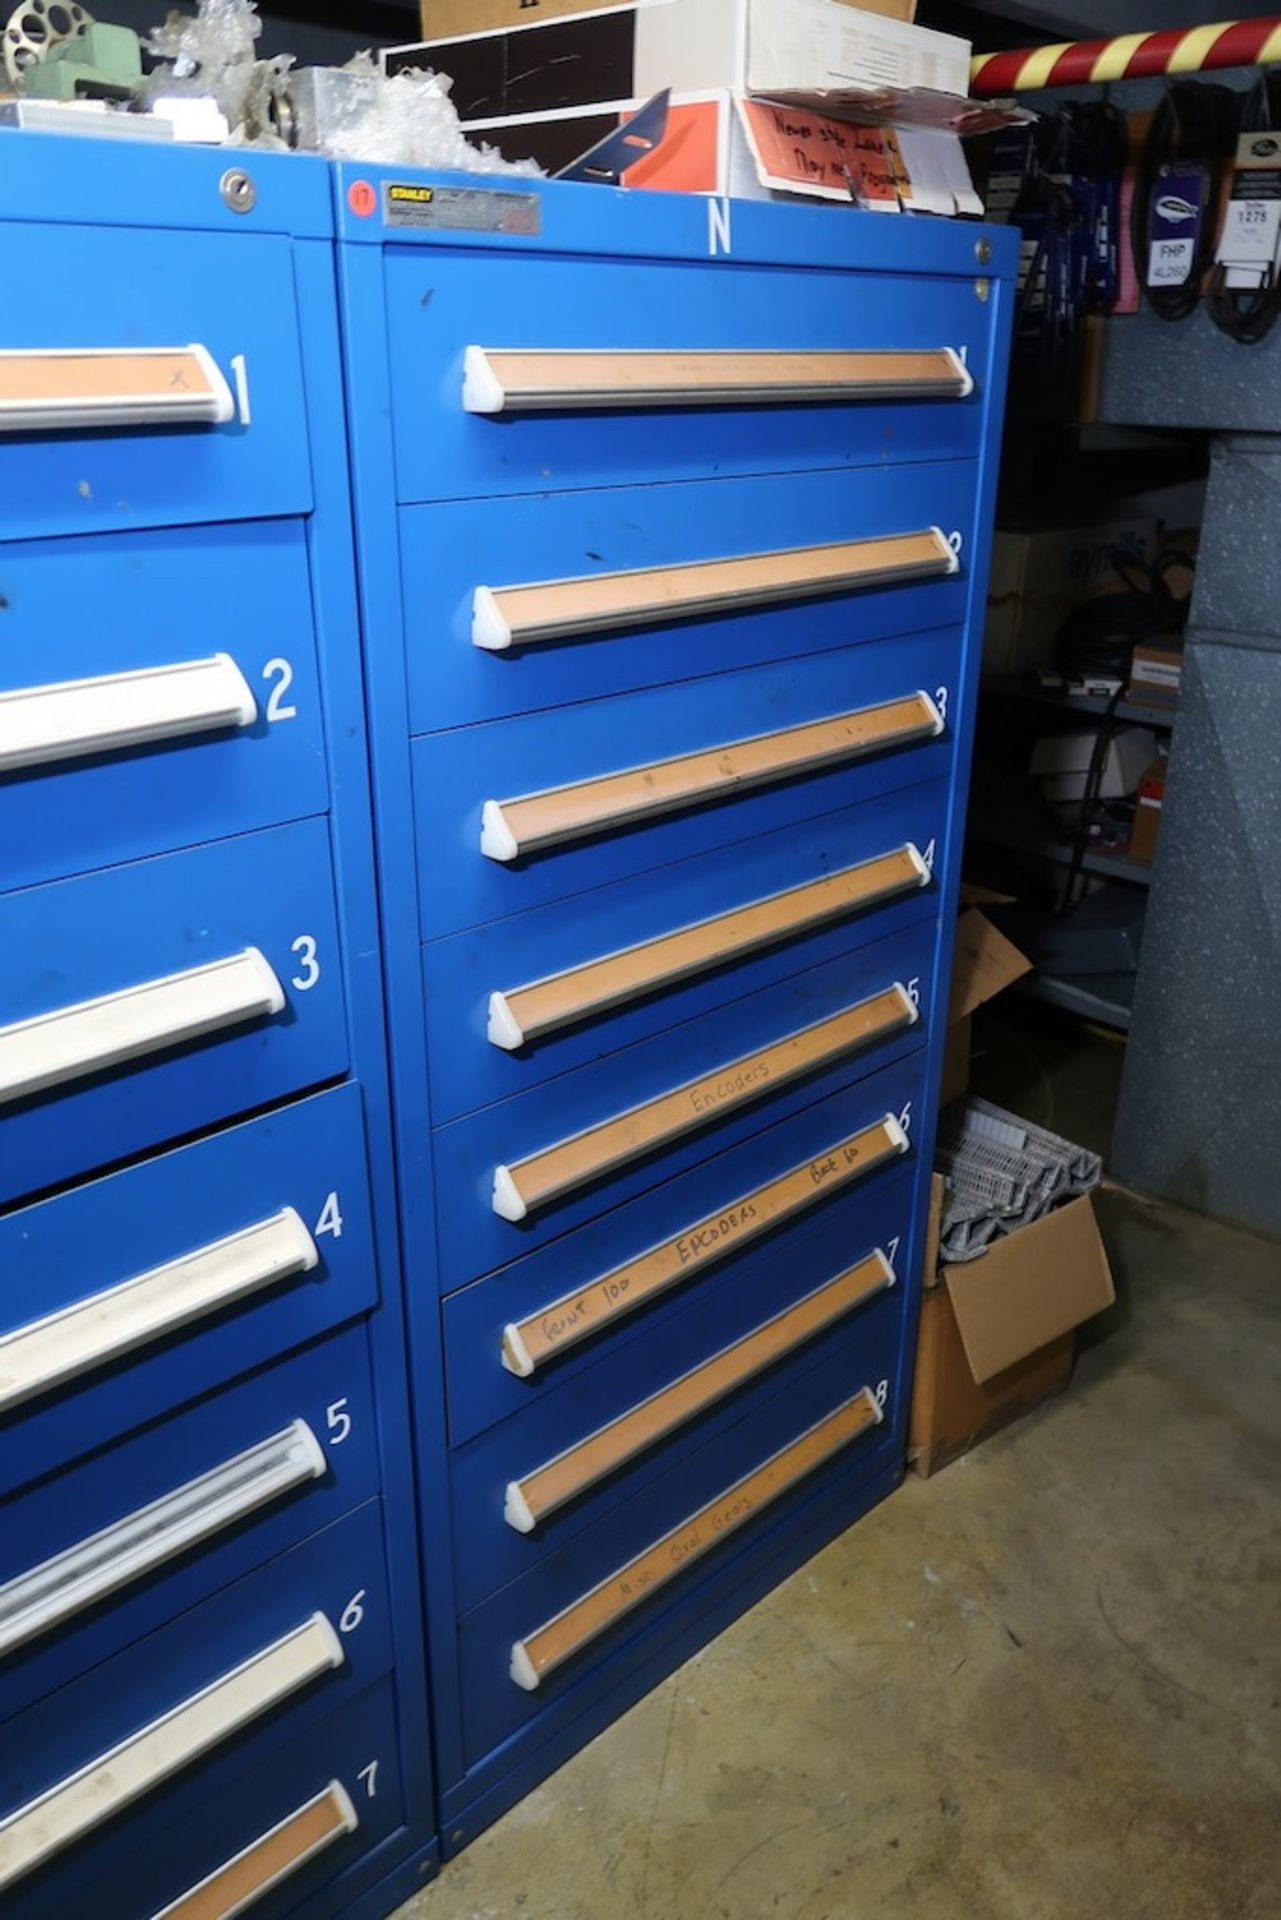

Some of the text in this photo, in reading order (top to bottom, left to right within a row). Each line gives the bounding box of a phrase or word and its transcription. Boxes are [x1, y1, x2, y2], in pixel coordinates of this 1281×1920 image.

[389, 187, 432, 202] STANLEY
[707, 197, 732, 256] N
[231, 354, 250, 426] 1
[262, 657, 297, 722] 2
[290, 934, 321, 991] 3
[688, 1062, 771, 1113] Encoders
[315, 1192, 344, 1239] 4
[674, 1203, 757, 1265] ENCODERS
[327, 1397, 352, 1445] 5
[339, 1589, 366, 1633] 6
[357, 1760, 379, 1798] 7
